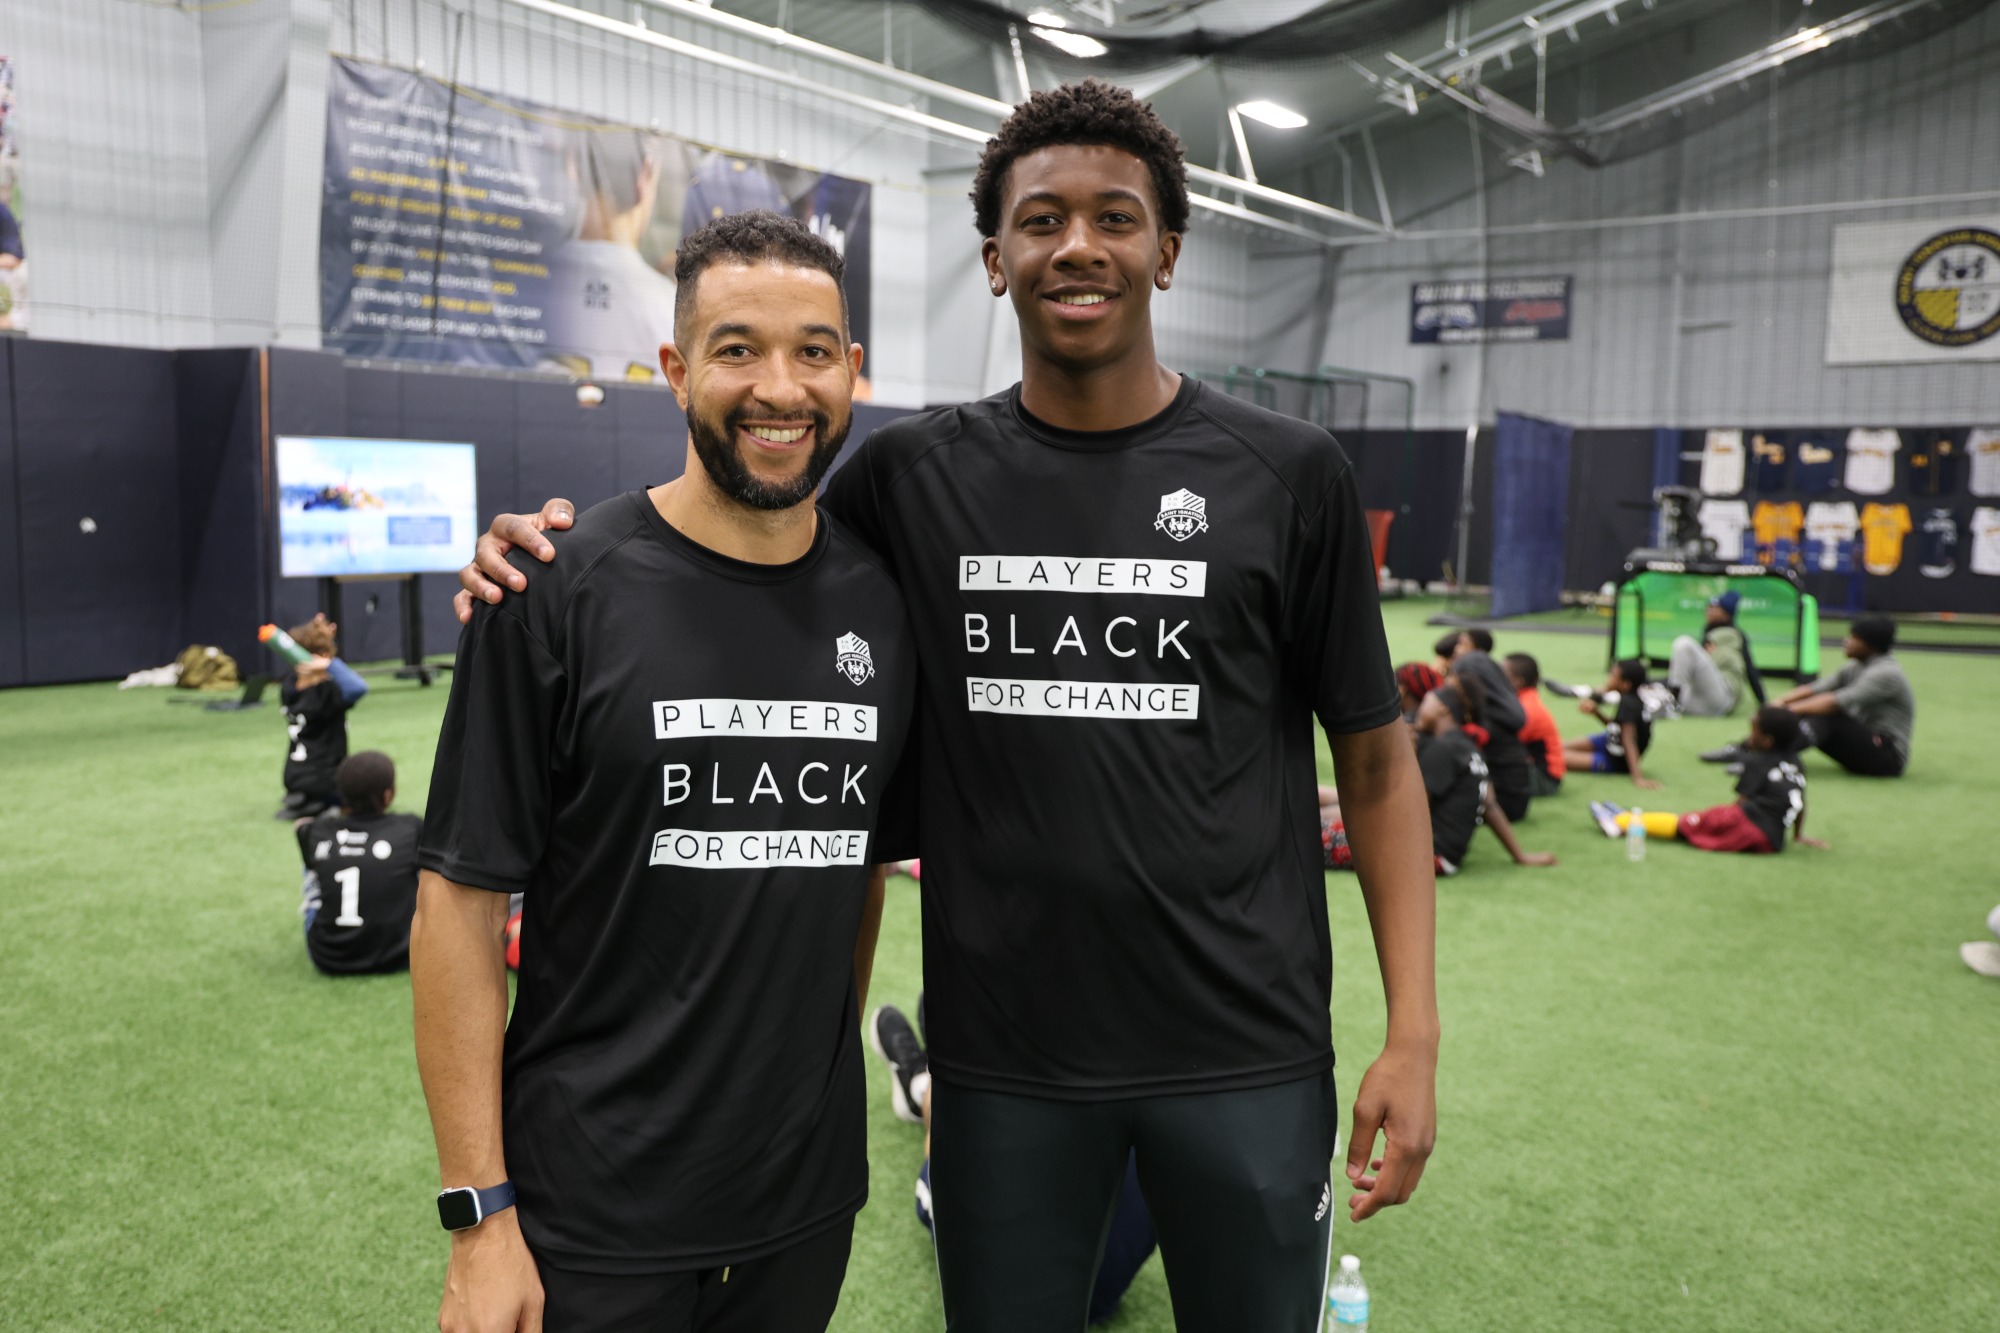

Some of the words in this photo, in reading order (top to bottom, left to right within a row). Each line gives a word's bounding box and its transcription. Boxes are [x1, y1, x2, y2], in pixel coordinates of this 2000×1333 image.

[1160, 510, 1177, 519] SAINT
[966, 560, 1188, 589] PLAYERS
[964, 613, 1191, 660] BLACK
[971, 682, 1025, 708] FOR
[1044, 685, 1190, 712] CHANGE
[662, 703, 867, 733] PLAYERS
[663, 761, 868, 807] BLACK
[654, 833, 723, 861] FOR
[739, 834, 861, 861] CHANGE
[334, 866, 364, 927] 1
